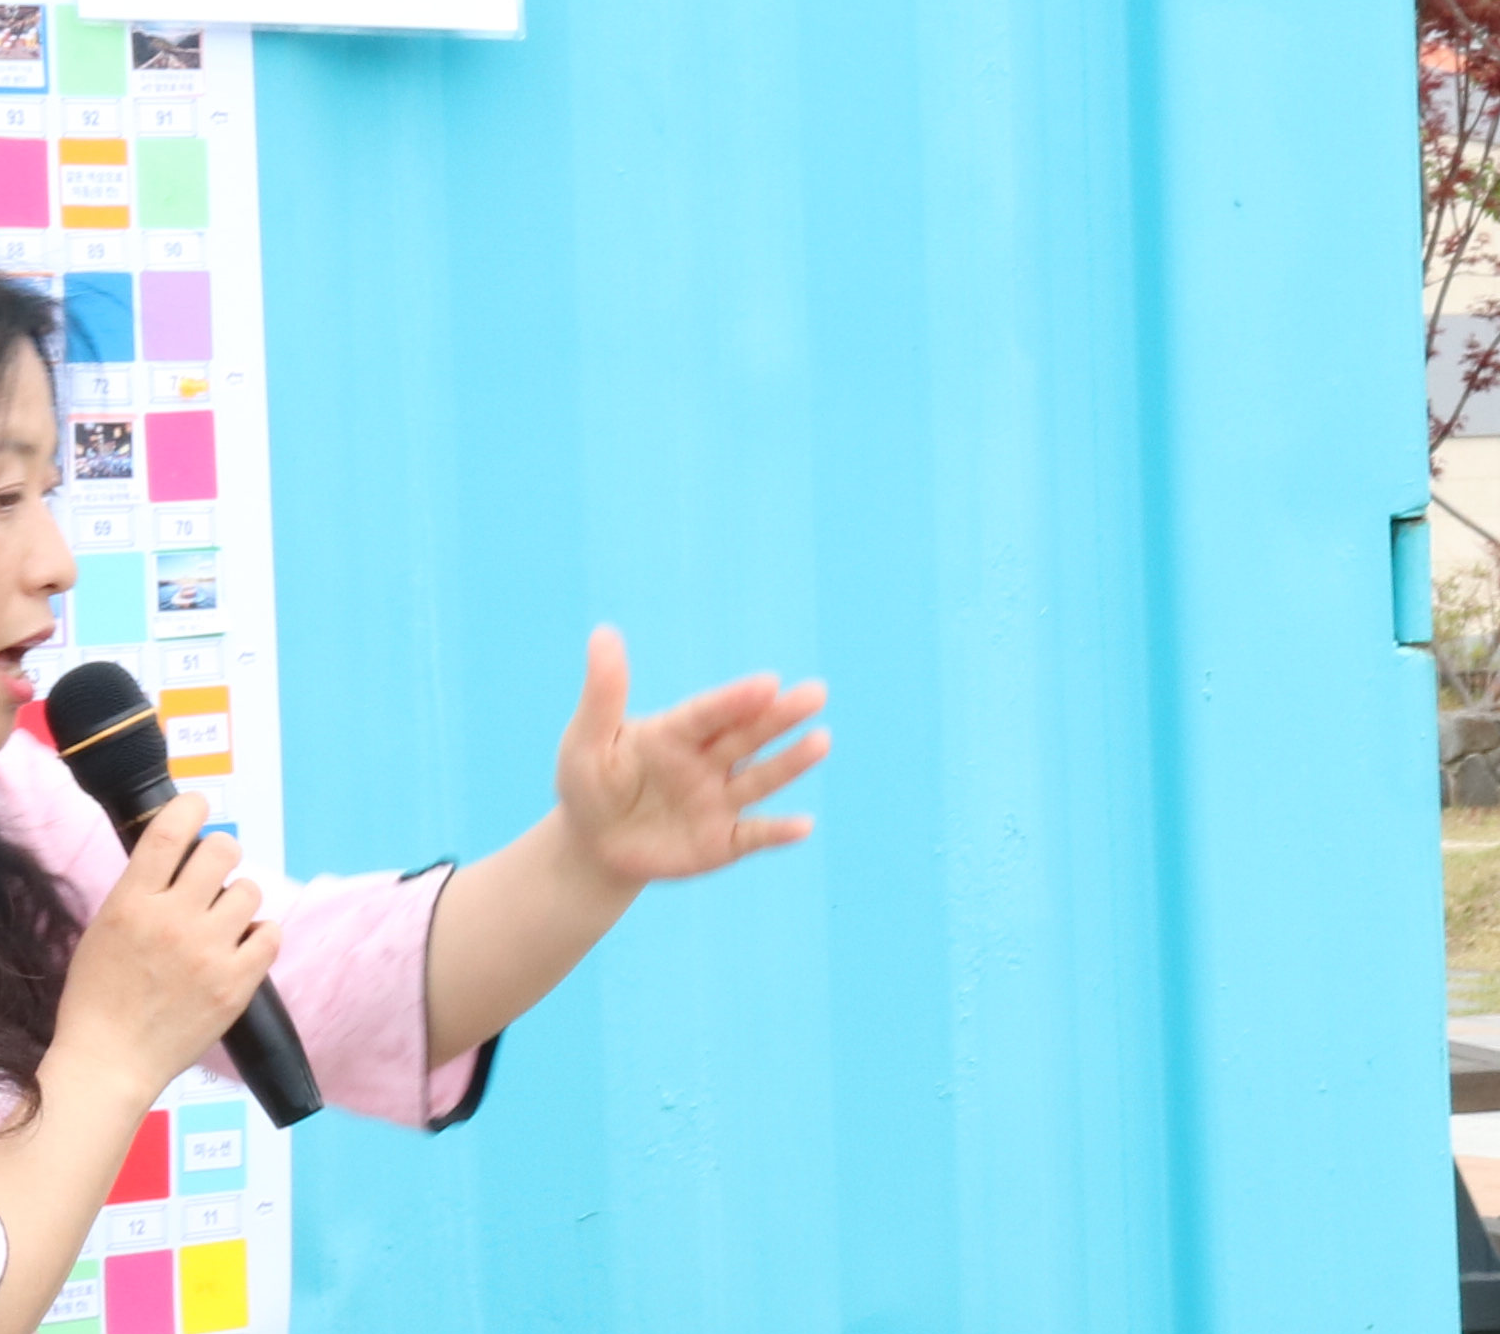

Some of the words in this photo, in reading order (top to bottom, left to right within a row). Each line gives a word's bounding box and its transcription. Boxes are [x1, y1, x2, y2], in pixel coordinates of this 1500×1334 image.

[5, 108, 26, 127] 93
[81, 109, 102, 127] 92
[154, 108, 174, 126] 91
[86, 242, 106, 259] 89
[163, 241, 183, 258] 90
[92, 376, 112, 395] 72
[92, 518, 113, 538] 69
[173, 518, 194, 538] 70
[181, 652, 201, 673] 51
[128, 1219, 146, 1236] 12
[202, 1209, 219, 1226] 11
